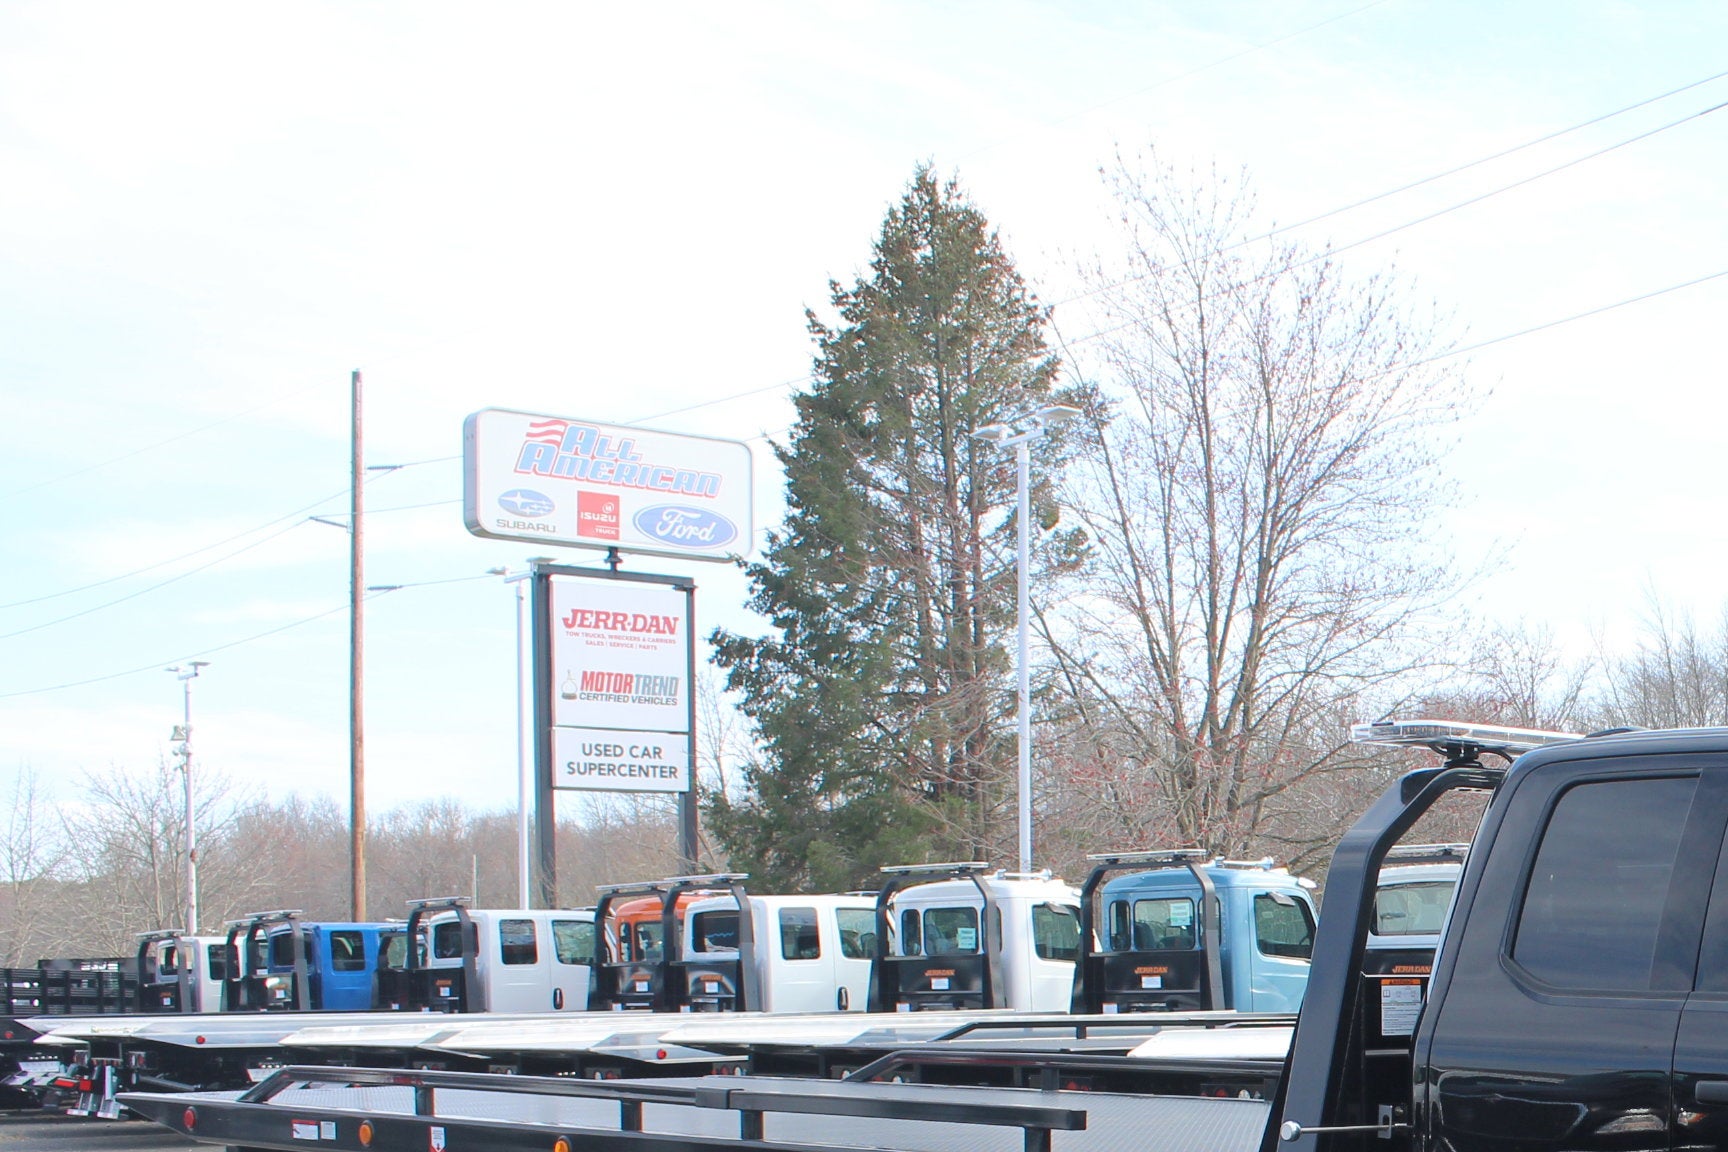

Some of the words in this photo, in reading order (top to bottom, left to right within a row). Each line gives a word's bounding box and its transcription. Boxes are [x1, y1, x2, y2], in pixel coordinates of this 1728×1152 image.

[580, 511, 617, 523] ISUZU
[655, 508, 716, 541] Ford
[496, 518, 556, 533] SUBARU
[594, 528, 616, 536] TRUCK
[579, 692, 629, 703] CERTIFIED
[631, 695, 678, 706] VEHICLES
[582, 743, 624, 757] USED
[629, 745, 662, 759] CAR
[567, 762, 678, 778] SUPERCENTER
